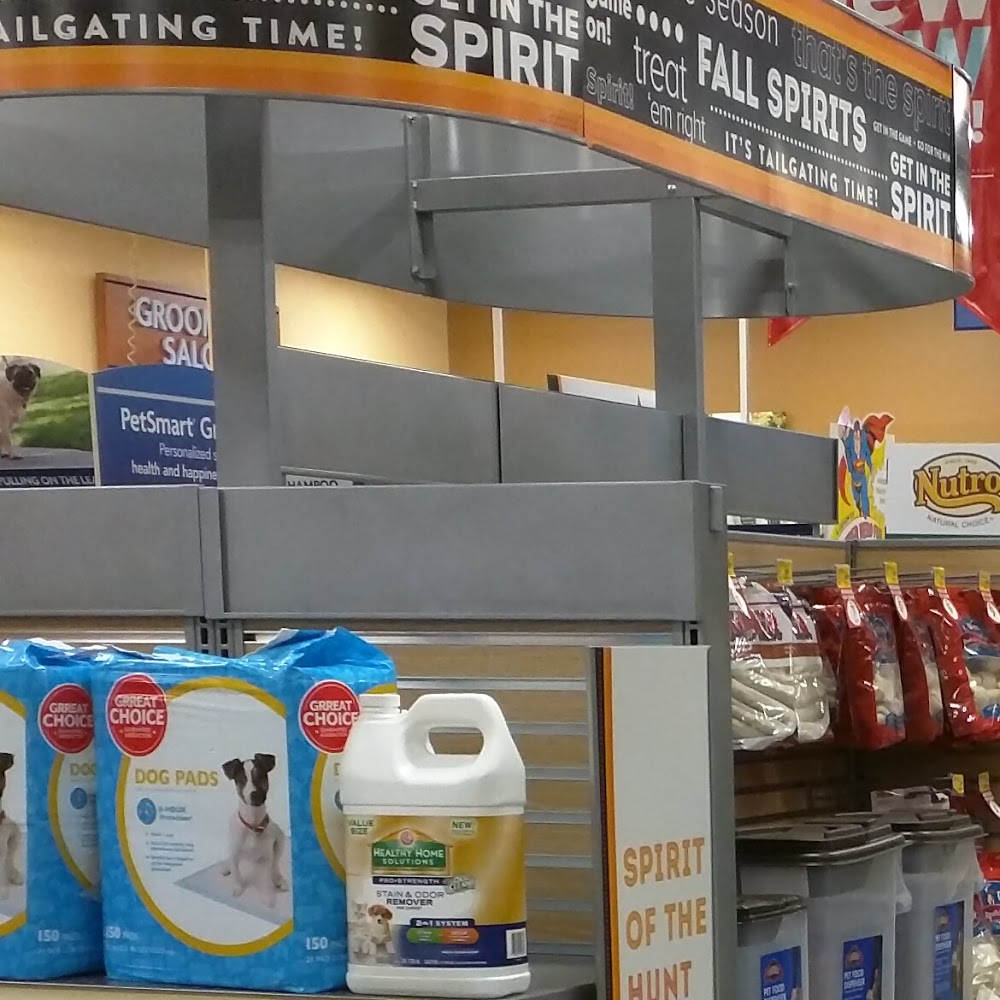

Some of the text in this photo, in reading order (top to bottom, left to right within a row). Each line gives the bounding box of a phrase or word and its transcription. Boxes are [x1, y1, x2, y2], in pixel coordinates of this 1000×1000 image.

[587, 0, 632, 20] ame
[530, 1, 580, 41] THE
[243, 17, 362, 51] TIME!
[585, 16, 612, 46] on!
[410, 14, 580, 97] SPIRIT
[633, 36, 689, 104] treat
[862, 54, 898, 110] the
[697, 33, 868, 153] FALL SPIRITS
[676, 108, 706, 144] right
[725, 131, 879, 208] IT'S TAILGATING TIME!
[890, 151, 951, 197] GET IN THE
[890, 181, 951, 239] SPIRIT
[120, 408, 193, 437] PetSmart
[159, 442, 212, 461] Personalized
[131, 459, 161, 476] health
[163, 465, 181, 478] and
[40, 475, 59, 485] ON
[59, 475, 79, 485] THE
[80, 475, 94, 485] LE
[927, 514, 990, 529] NATURAL CHOICE
[114, 694, 157, 708] GRREAT
[309, 700, 353, 711] GRREAT
[43, 713, 94, 728] CHOICE
[109, 708, 165, 726] CHOICE
[135, 768, 219, 787] DOG PADS
[351, 827, 368, 835] SIZE
[452, 821, 473, 829] NEW
[373, 848, 444, 858] HEALTHY HOME
[382, 858, 434, 866] SOLUTIONS
[623, 837, 705, 888] SPIRIT
[386, 898, 433, 906] REMOVER
[626, 896, 707, 950] OF THE
[37, 929, 59, 942] 150
[305, 936, 329, 950] 150
